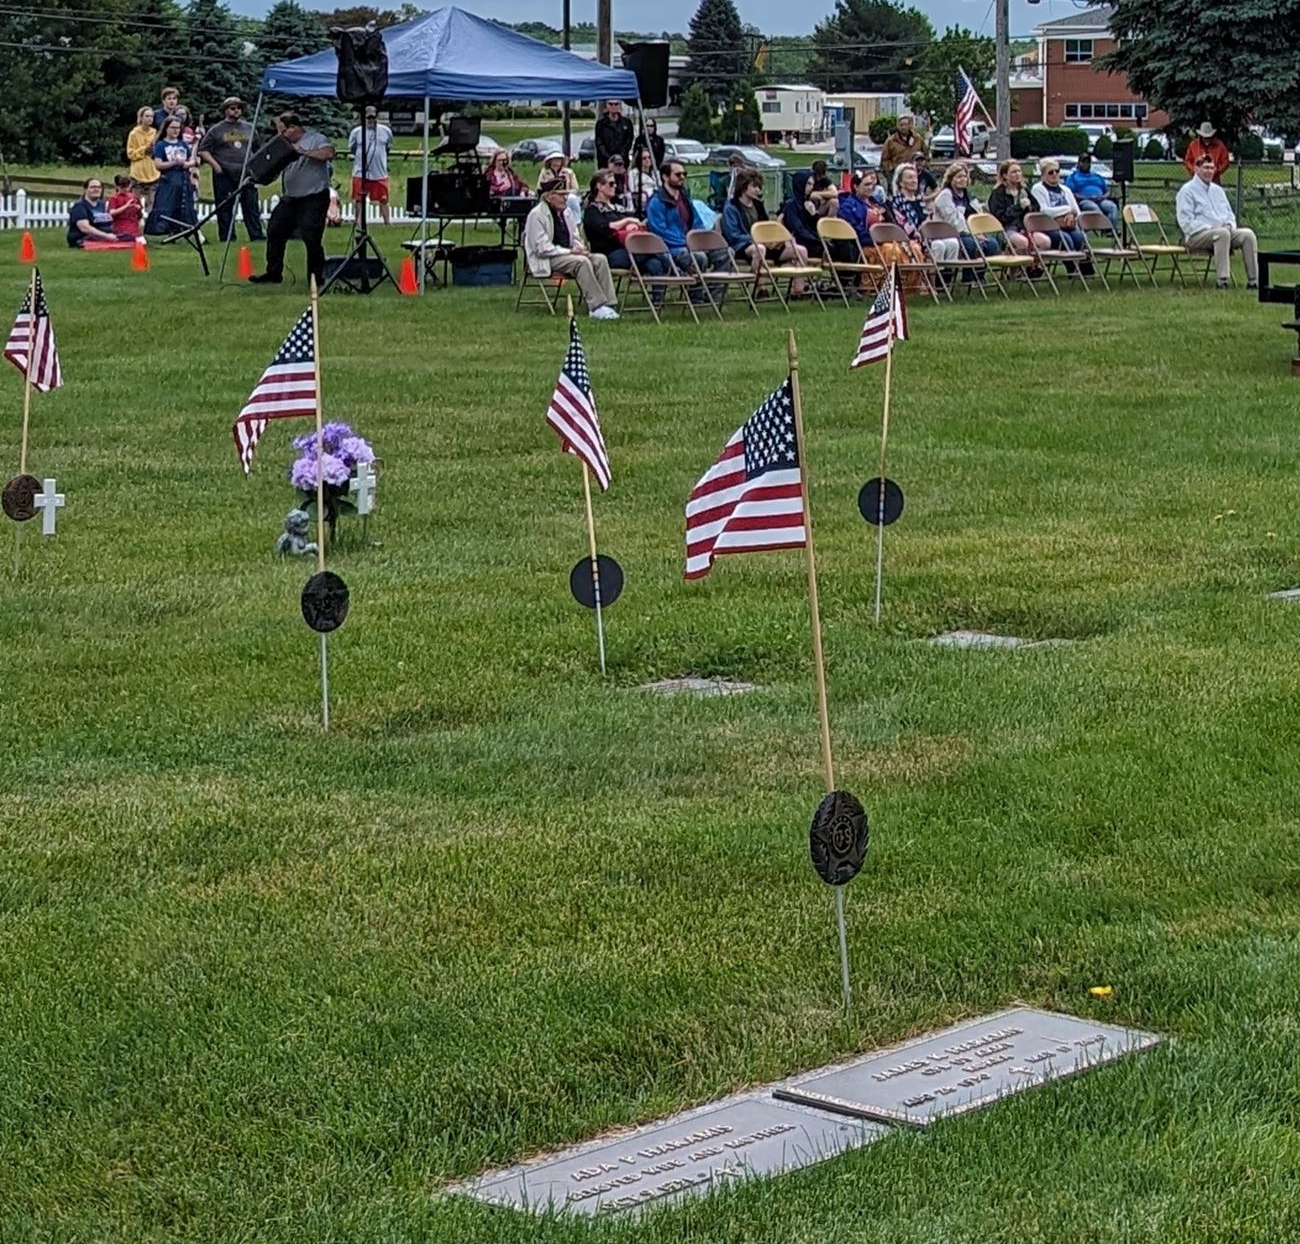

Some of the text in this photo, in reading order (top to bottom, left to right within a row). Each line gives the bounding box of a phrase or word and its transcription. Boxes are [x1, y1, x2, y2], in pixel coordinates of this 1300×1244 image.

[871, 1059, 931, 1082] JAMES
[640, 1158, 686, 1176] WIFE
[687, 1146, 725, 1163] AND
[723, 1123, 797, 1150] MOTHER
[570, 1163, 619, 1182] ADA
